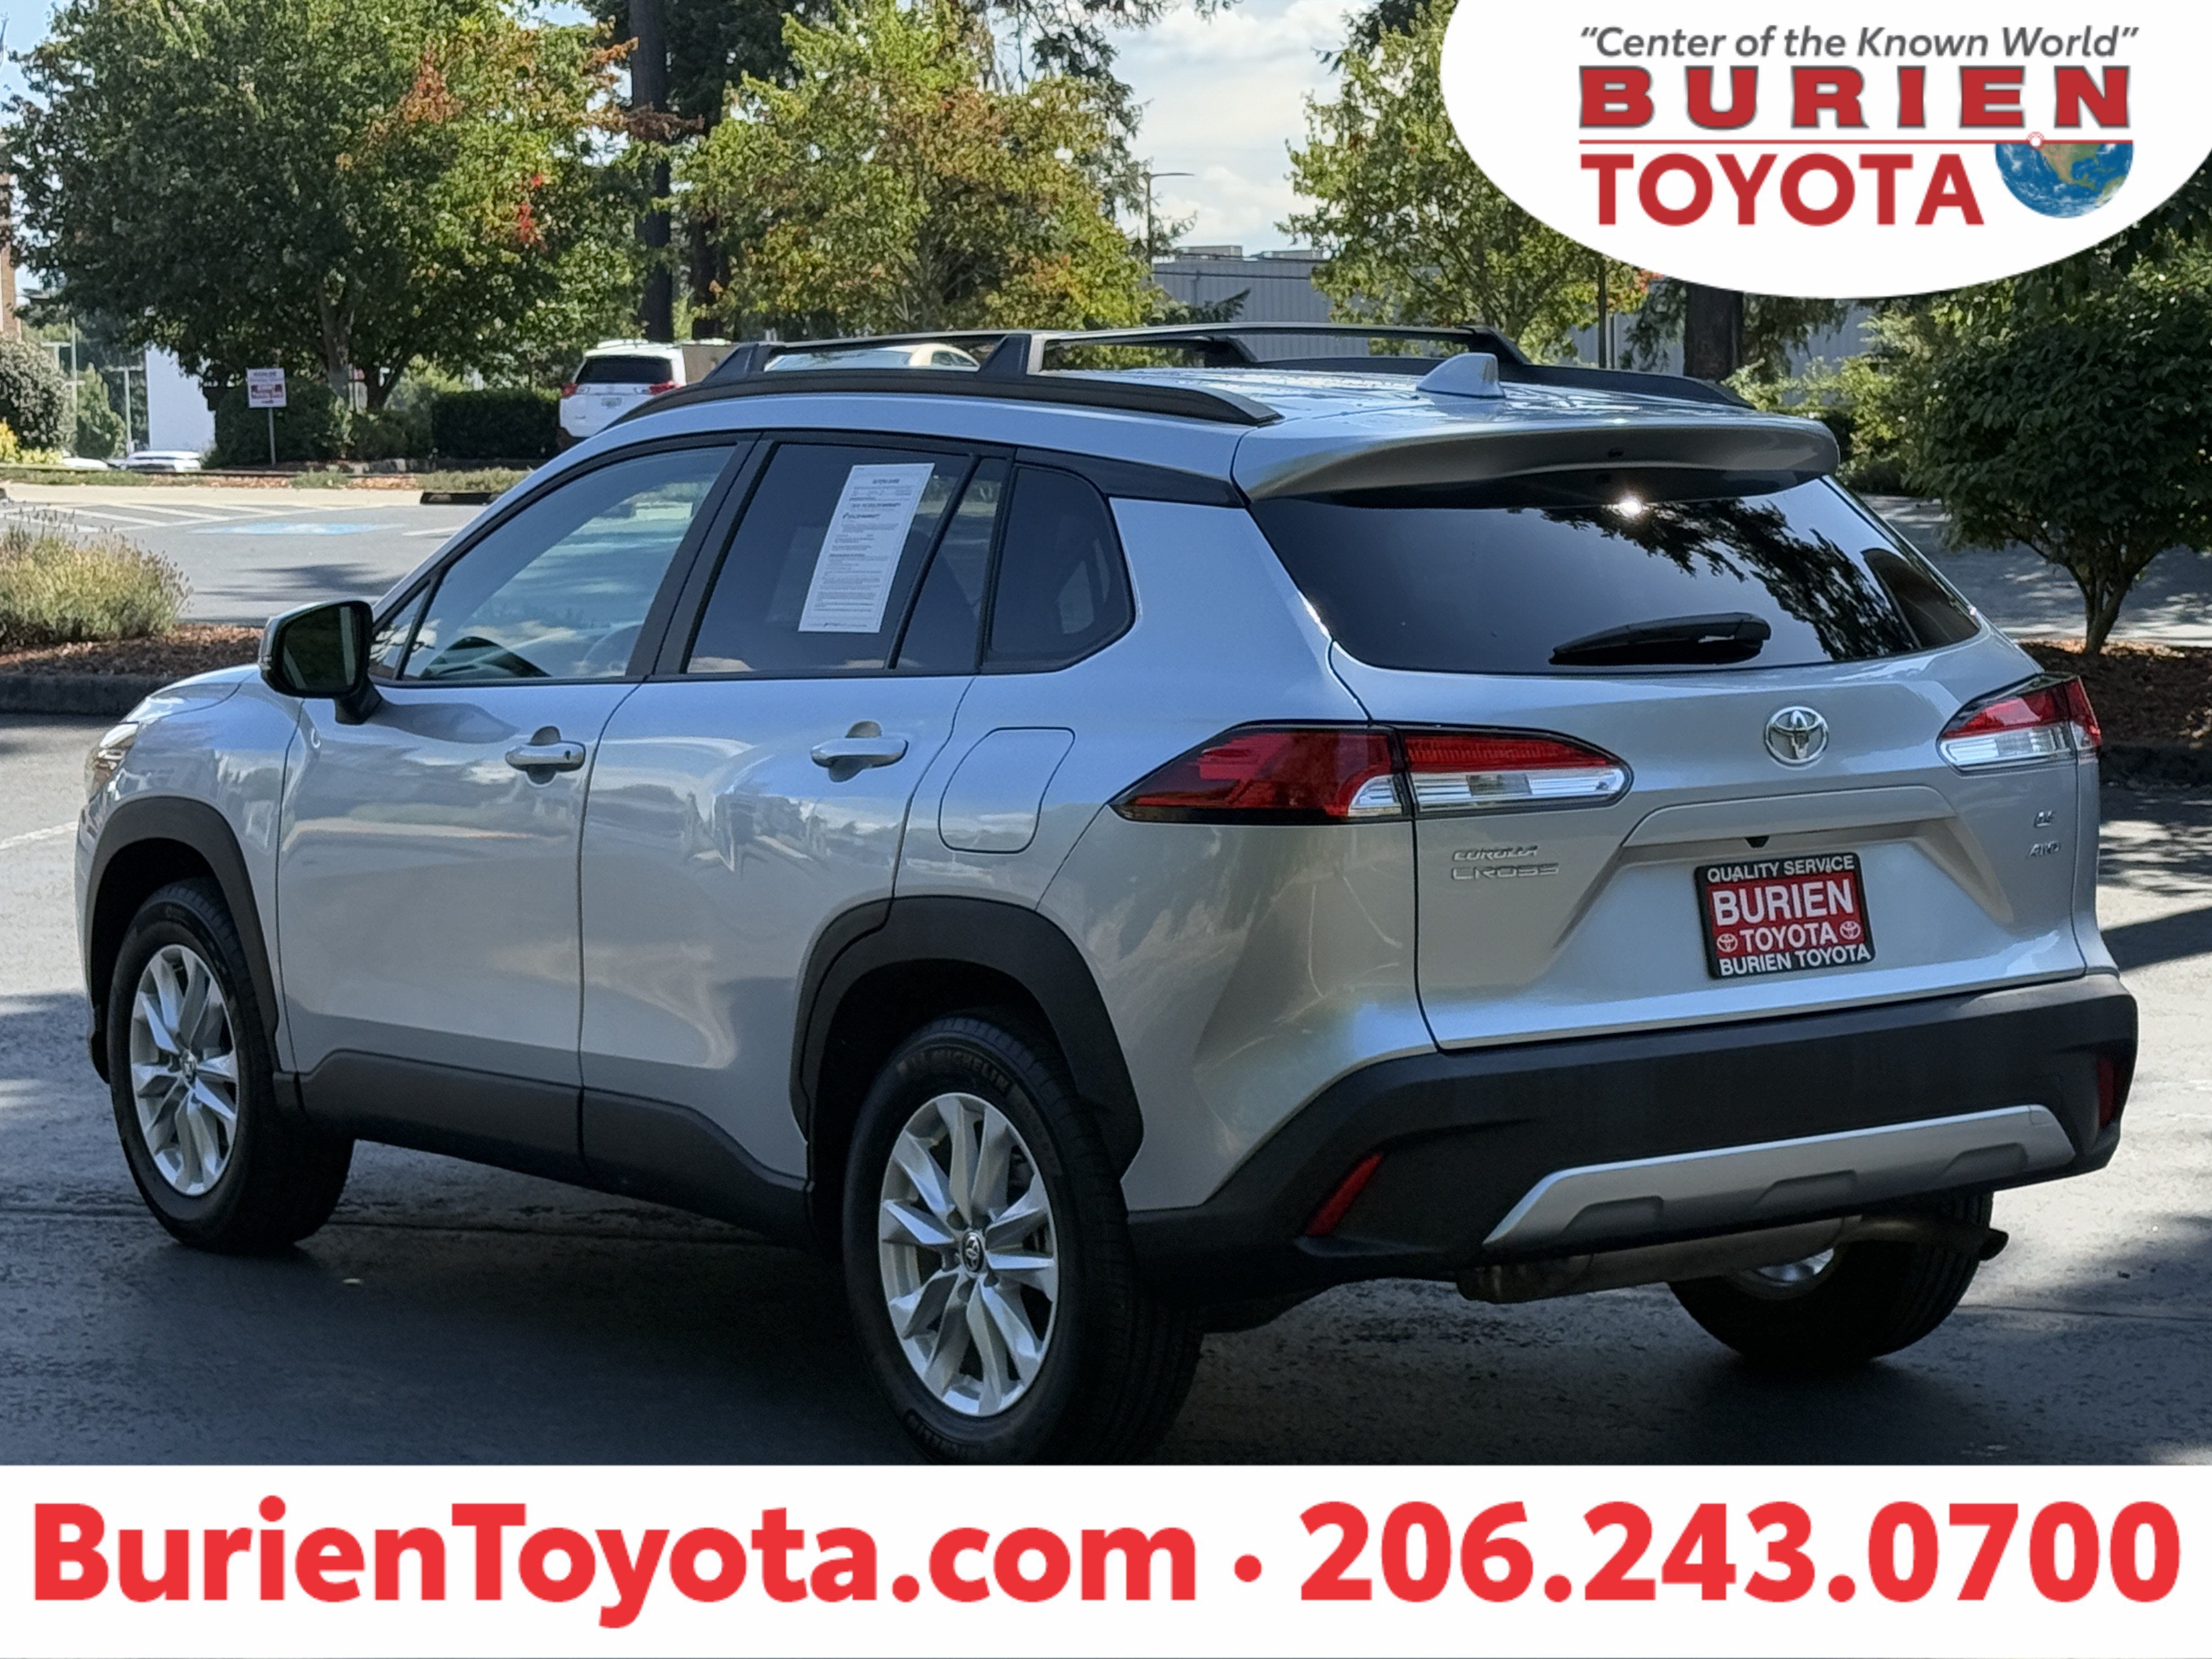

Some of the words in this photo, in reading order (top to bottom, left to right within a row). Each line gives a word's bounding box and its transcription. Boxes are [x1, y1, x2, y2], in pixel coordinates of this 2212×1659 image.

[1451, 863, 1559, 880] CROSS
[1707, 862, 1779, 883] QUALITY
[1784, 855, 1855, 876] SERVICE
[1713, 879, 1854, 926] BURIEN
[1740, 922, 1838, 953] TOYOTA
[1719, 952, 1792, 977] BURIEN
[1795, 943, 1871, 969] TOYOTA
